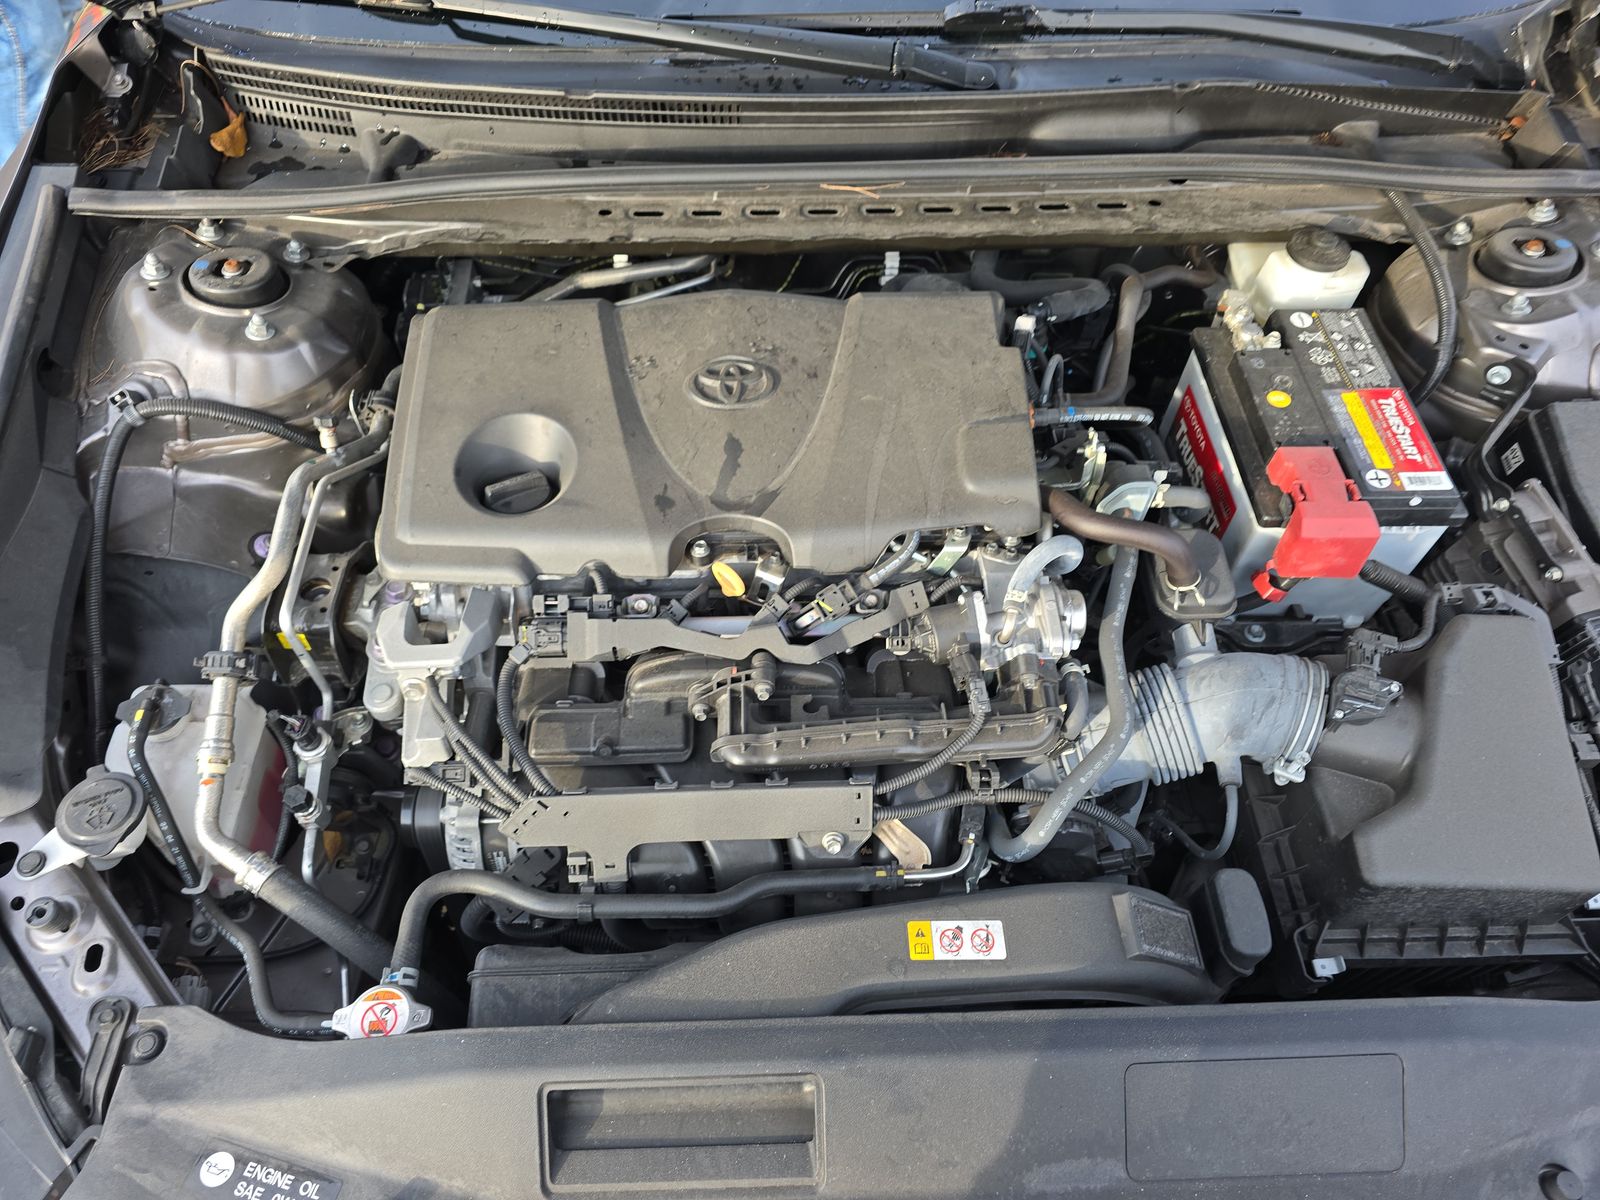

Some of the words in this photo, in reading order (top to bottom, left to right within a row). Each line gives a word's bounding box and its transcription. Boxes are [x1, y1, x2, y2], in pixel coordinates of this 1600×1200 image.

[1189, 410, 1206, 452] TOYOTA
[1397, 398, 1416, 427] TOYOTA
[243, 1161, 296, 1190] ENGINE
[298, 1180, 321, 1199] OIL
